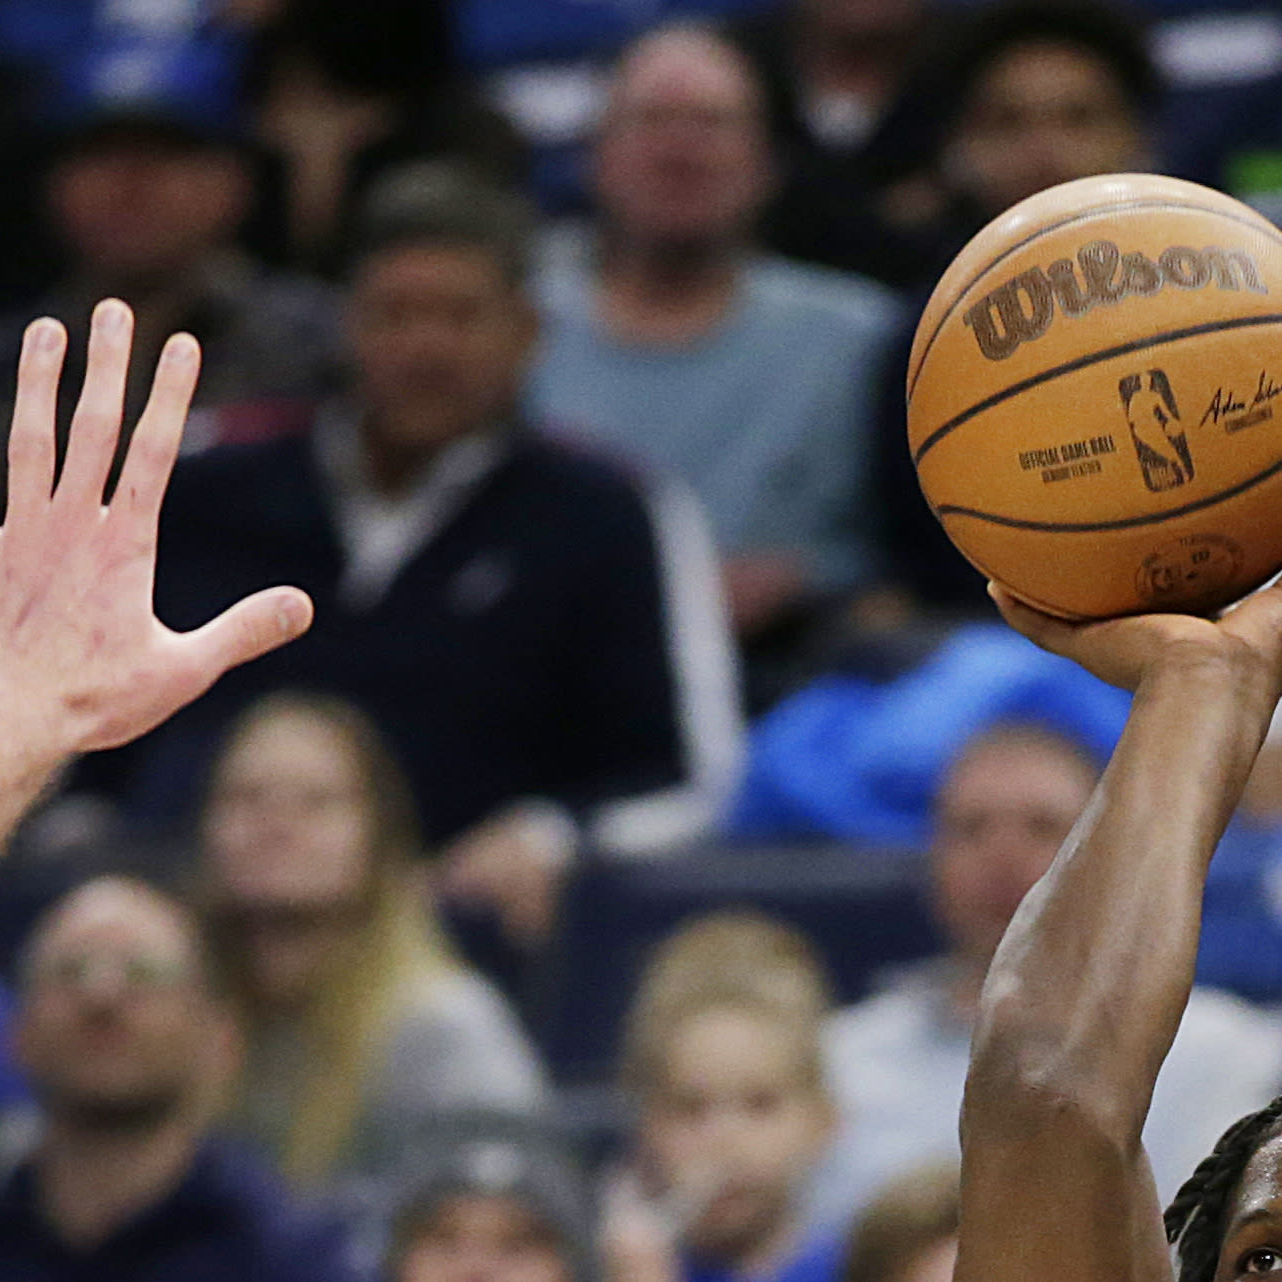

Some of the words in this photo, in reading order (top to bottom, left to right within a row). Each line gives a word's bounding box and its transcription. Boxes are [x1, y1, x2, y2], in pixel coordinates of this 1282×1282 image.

[962, 240, 1268, 361] Wilson
[1019, 446, 1060, 471] OFFICIAL
[1061, 440, 1090, 462] GAME
